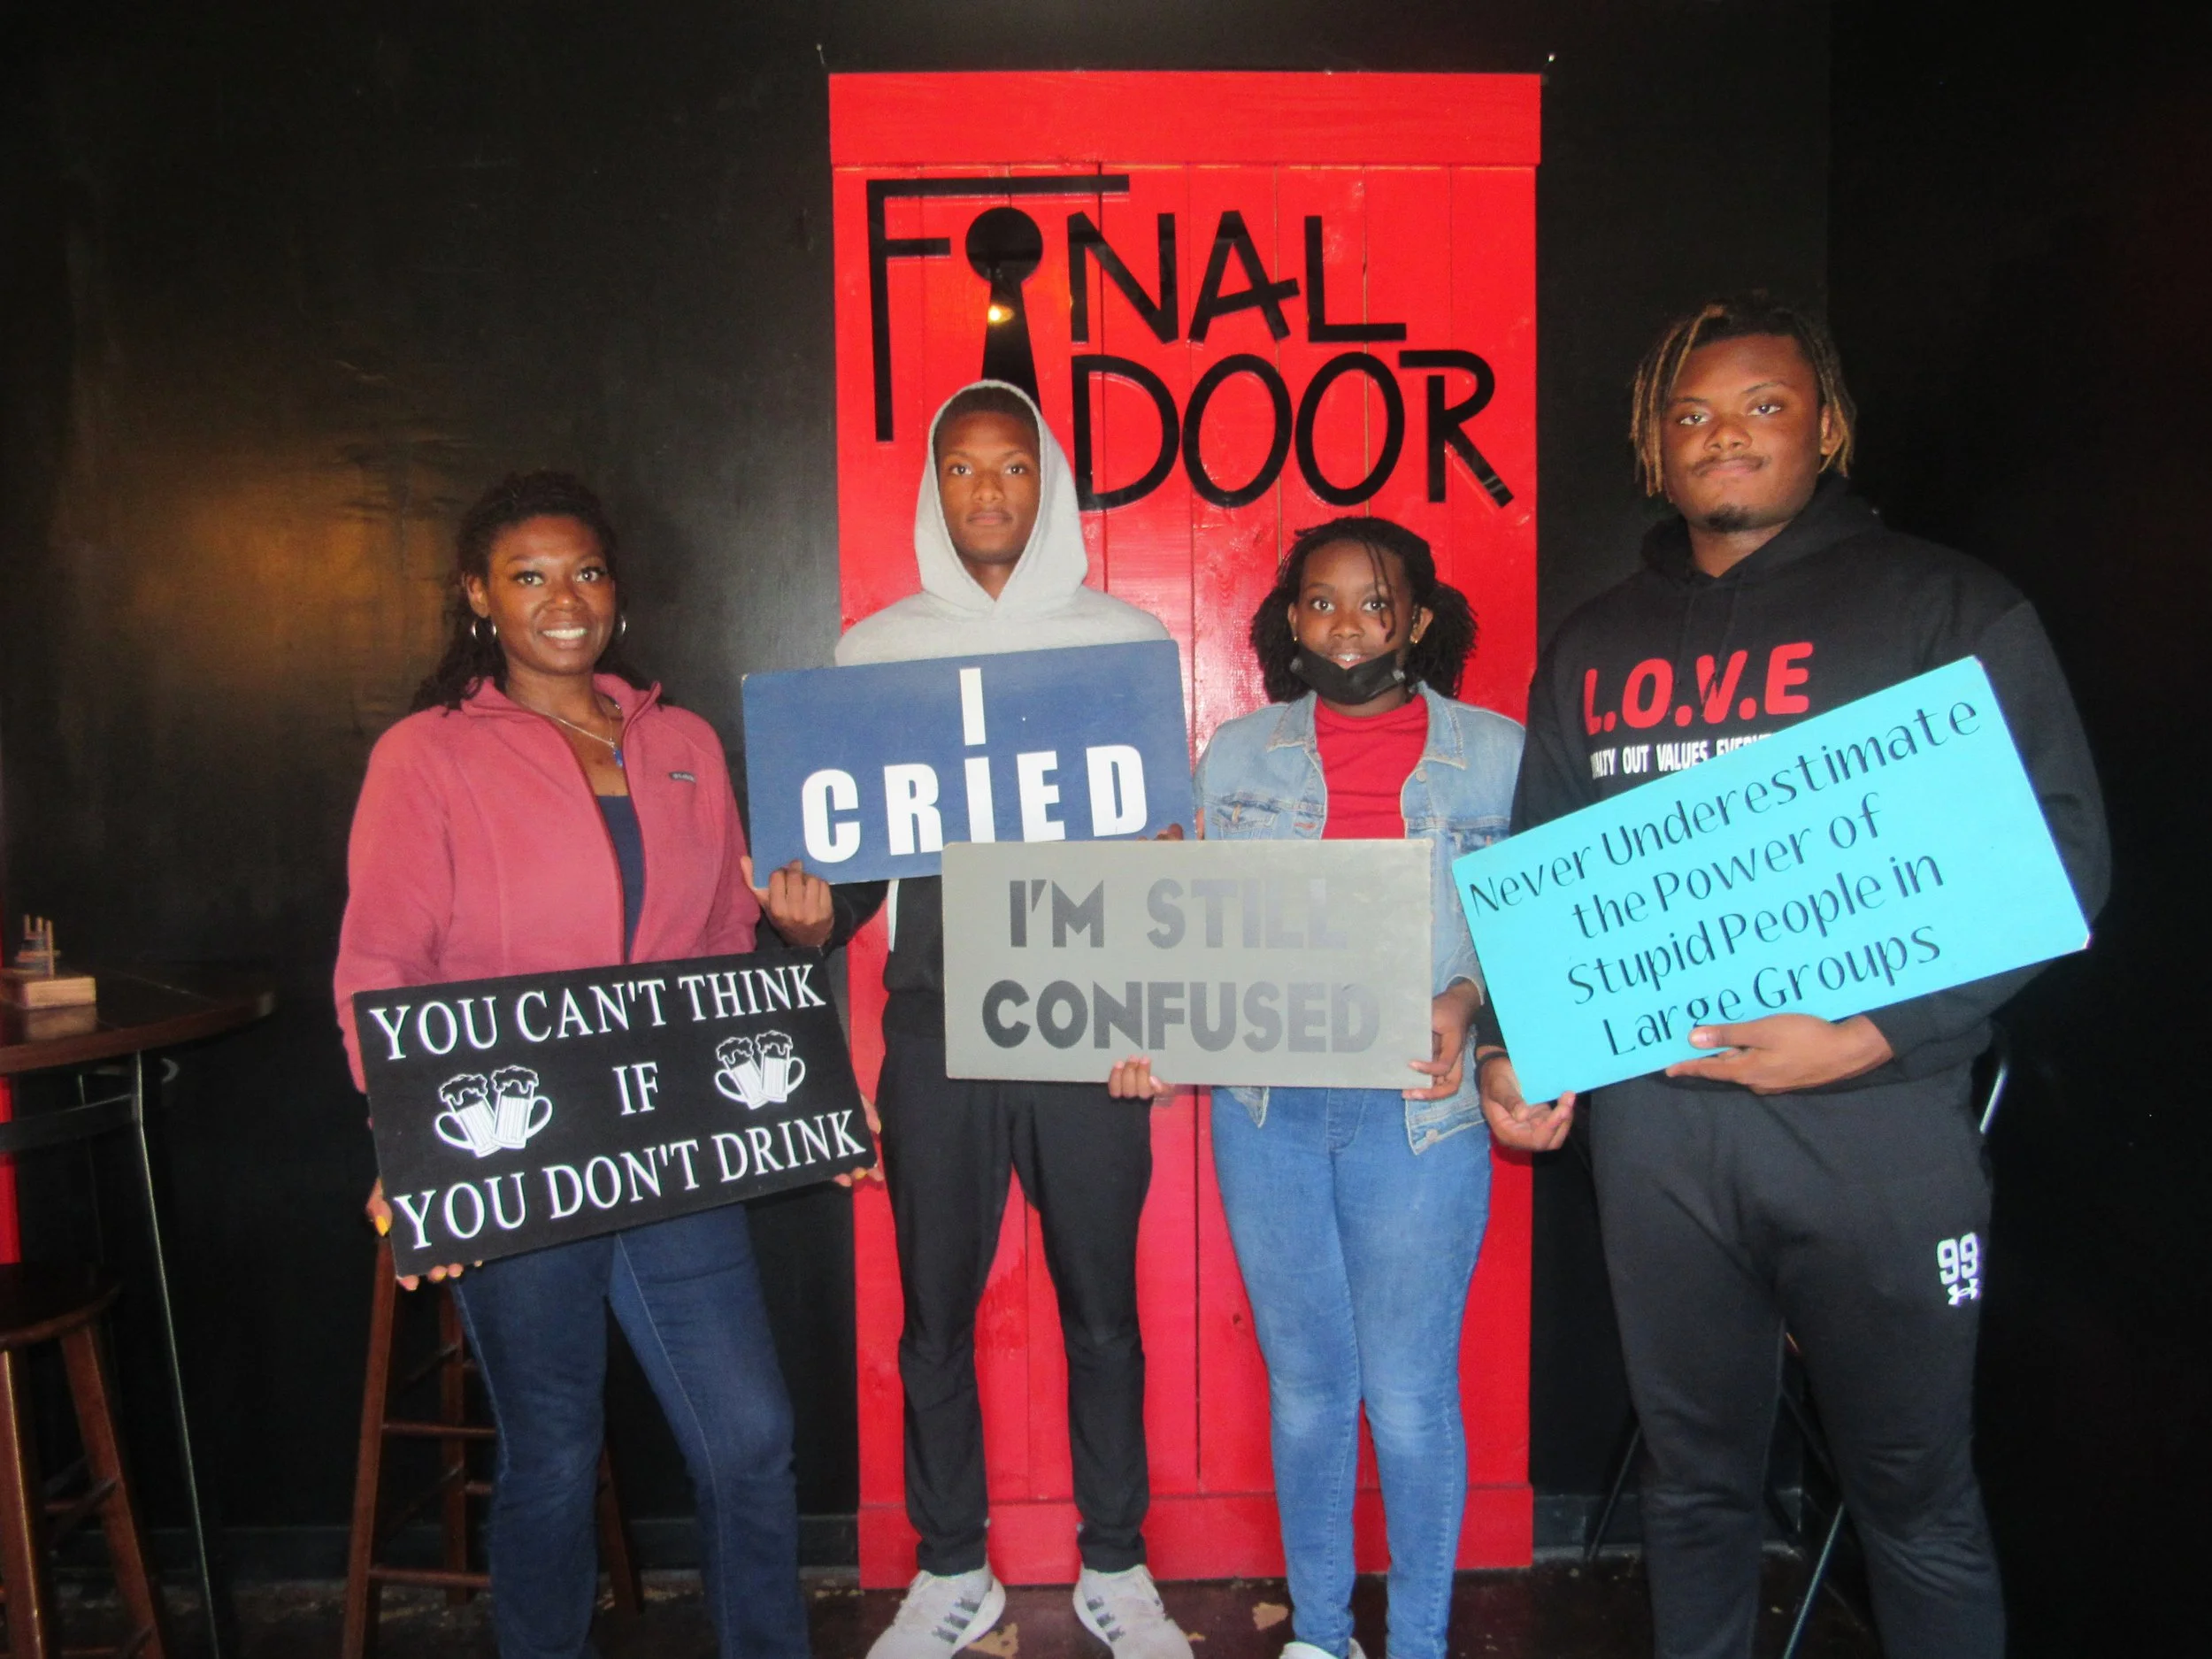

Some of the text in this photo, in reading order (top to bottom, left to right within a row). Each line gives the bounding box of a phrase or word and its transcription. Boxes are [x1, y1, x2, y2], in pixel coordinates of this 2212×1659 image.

[1071, 349, 1515, 511] DOOR
[959, 667, 987, 746] I
[1622, 743, 1650, 775] OUT
[1655, 740, 1709, 772] VALUES
[802, 744, 1148, 864] CRIED
[1468, 700, 1982, 918] Never Underestimate
[1009, 878, 1348, 950] I'M STILL
[1572, 792, 1882, 940] the Power of
[1567, 854, 1944, 1005] Stupid People in
[370, 964, 826, 1061] YOU CAN'T THINK
[981, 979, 1381, 1054] CONFUSED
[1603, 925, 1941, 1057] Large Groups
[612, 1062, 659, 1116] IF
[394, 1110, 867, 1249] YOU DON'T DRINK
[1936, 1231, 1978, 1286] 99
